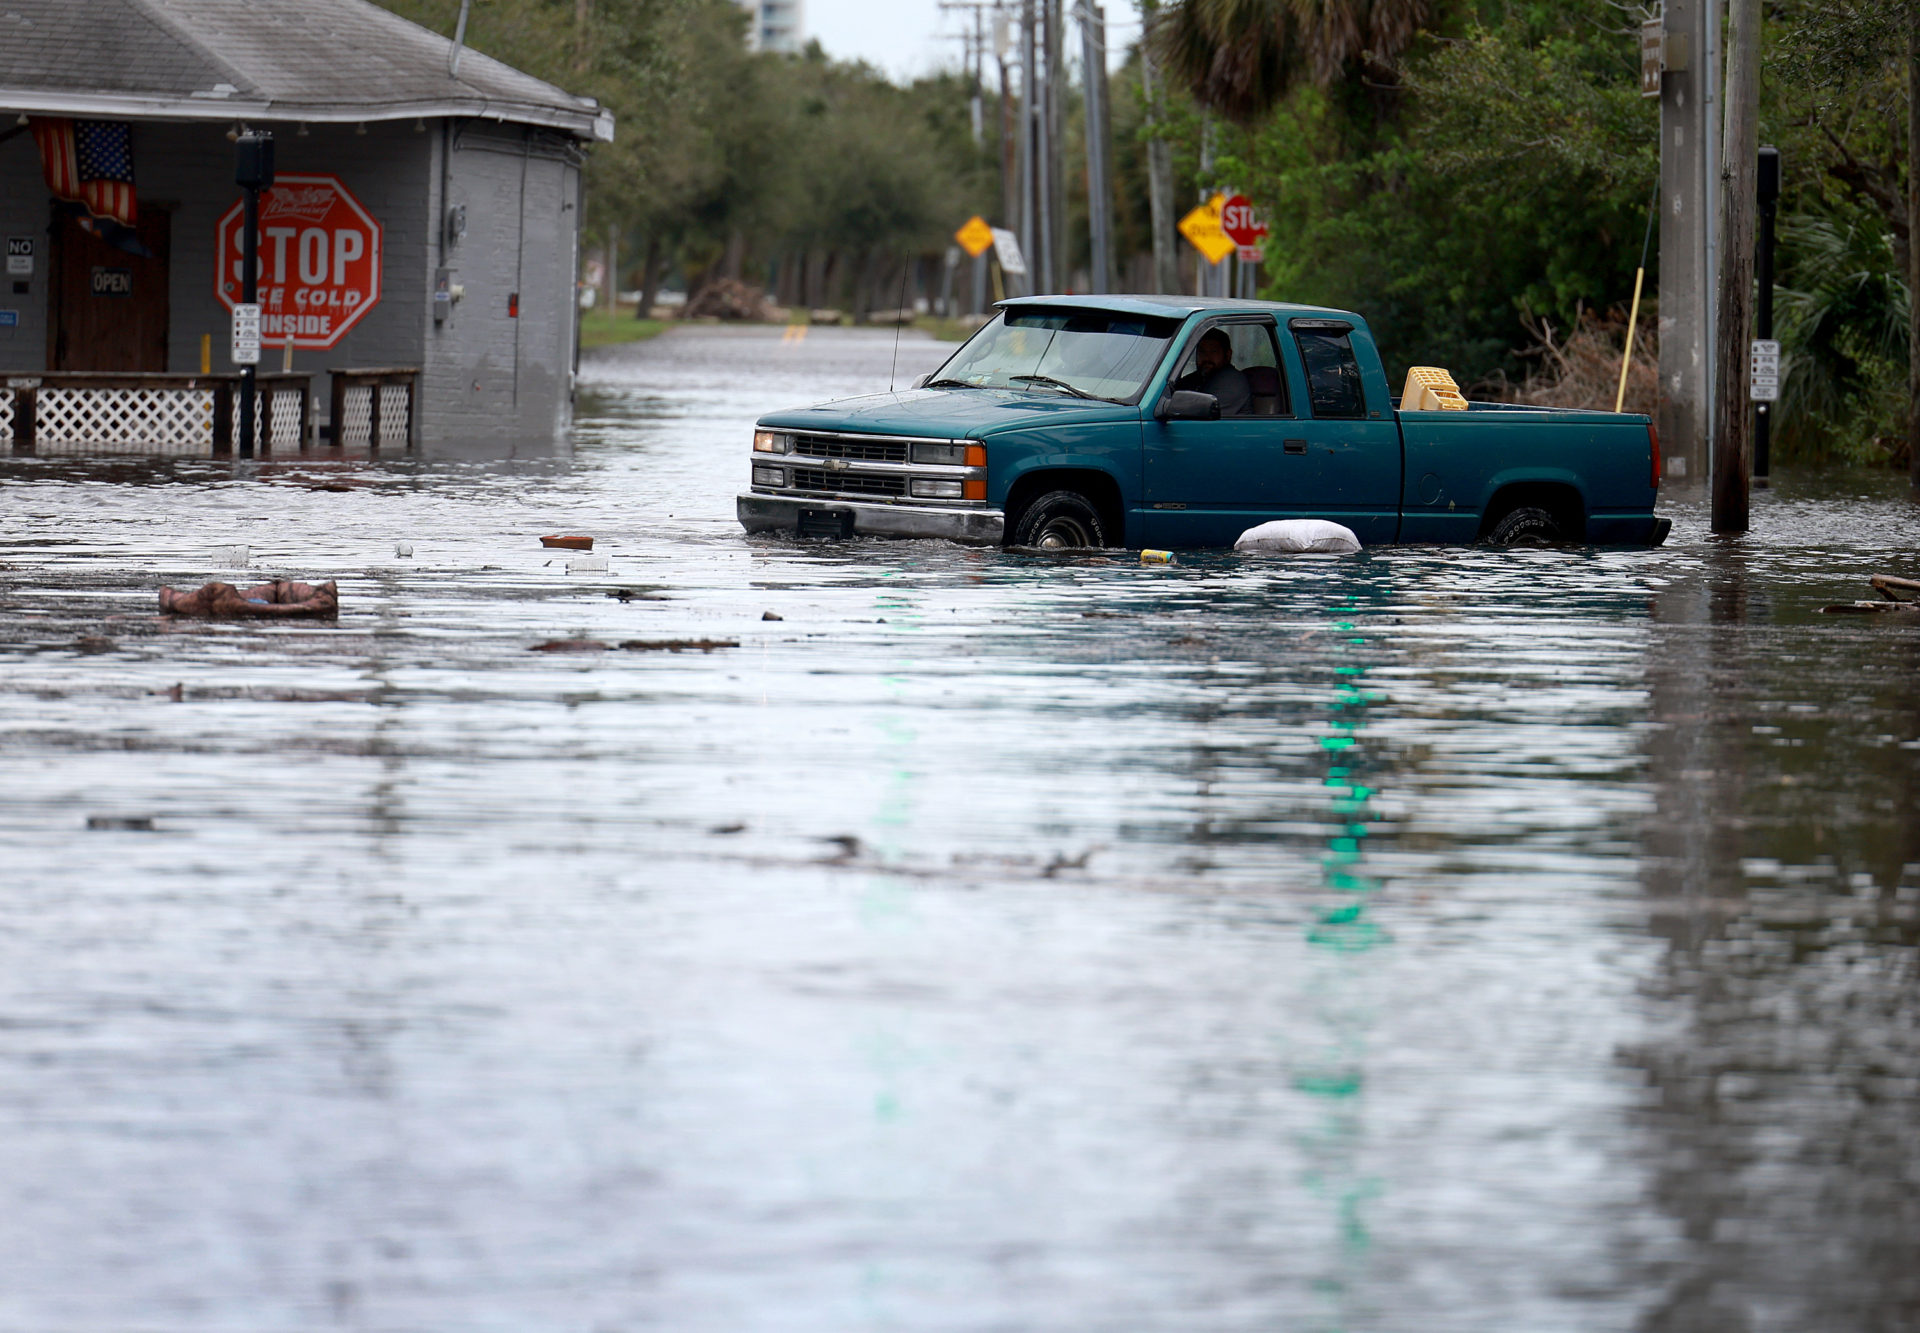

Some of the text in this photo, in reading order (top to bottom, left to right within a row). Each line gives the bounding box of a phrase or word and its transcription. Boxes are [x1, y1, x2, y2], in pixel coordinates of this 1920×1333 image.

[1224, 205, 1268, 230] STO
[9, 240, 32, 254] NO
[233, 227, 363, 286] STOP
[94, 273, 129, 292] OPEN
[255, 286, 361, 307] CE COLD
[262, 314, 331, 334] INSIDE
